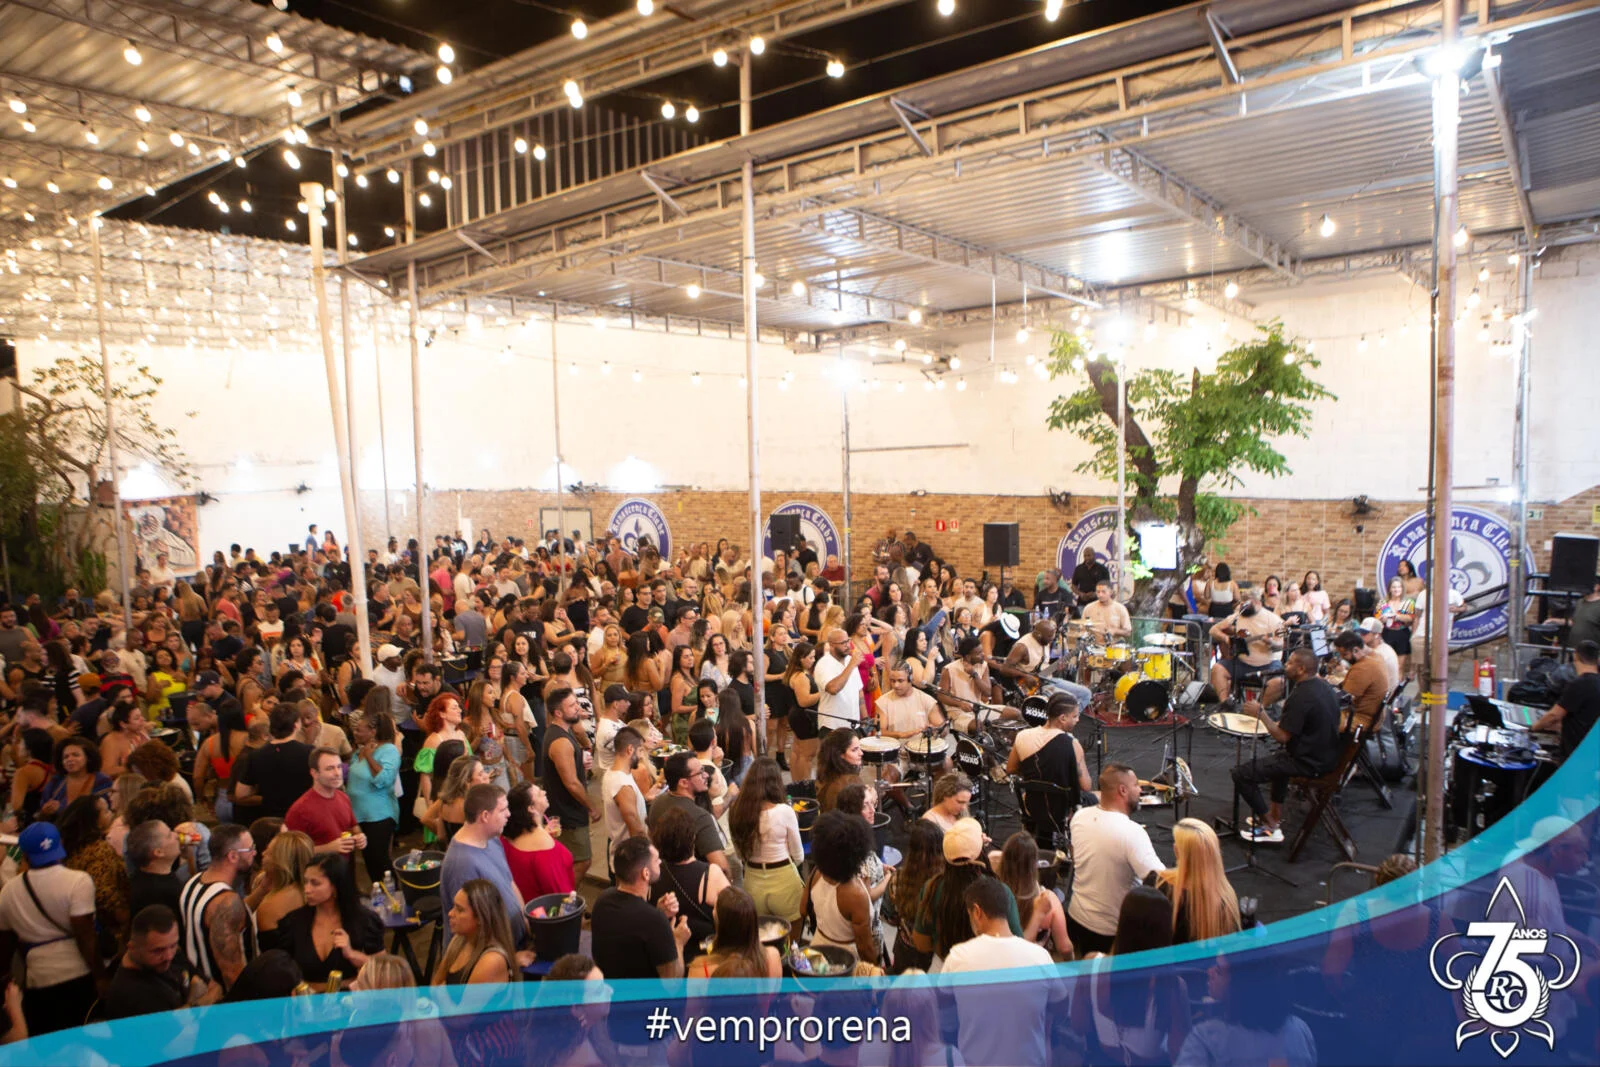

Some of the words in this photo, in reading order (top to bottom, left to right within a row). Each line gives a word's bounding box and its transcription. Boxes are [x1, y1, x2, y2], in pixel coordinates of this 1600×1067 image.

[811, 512, 833, 542] Clube
[1064, 513, 1114, 552] Renasce
[1388, 516, 1480, 560] Renança
[1482, 522, 1511, 558] Clu
